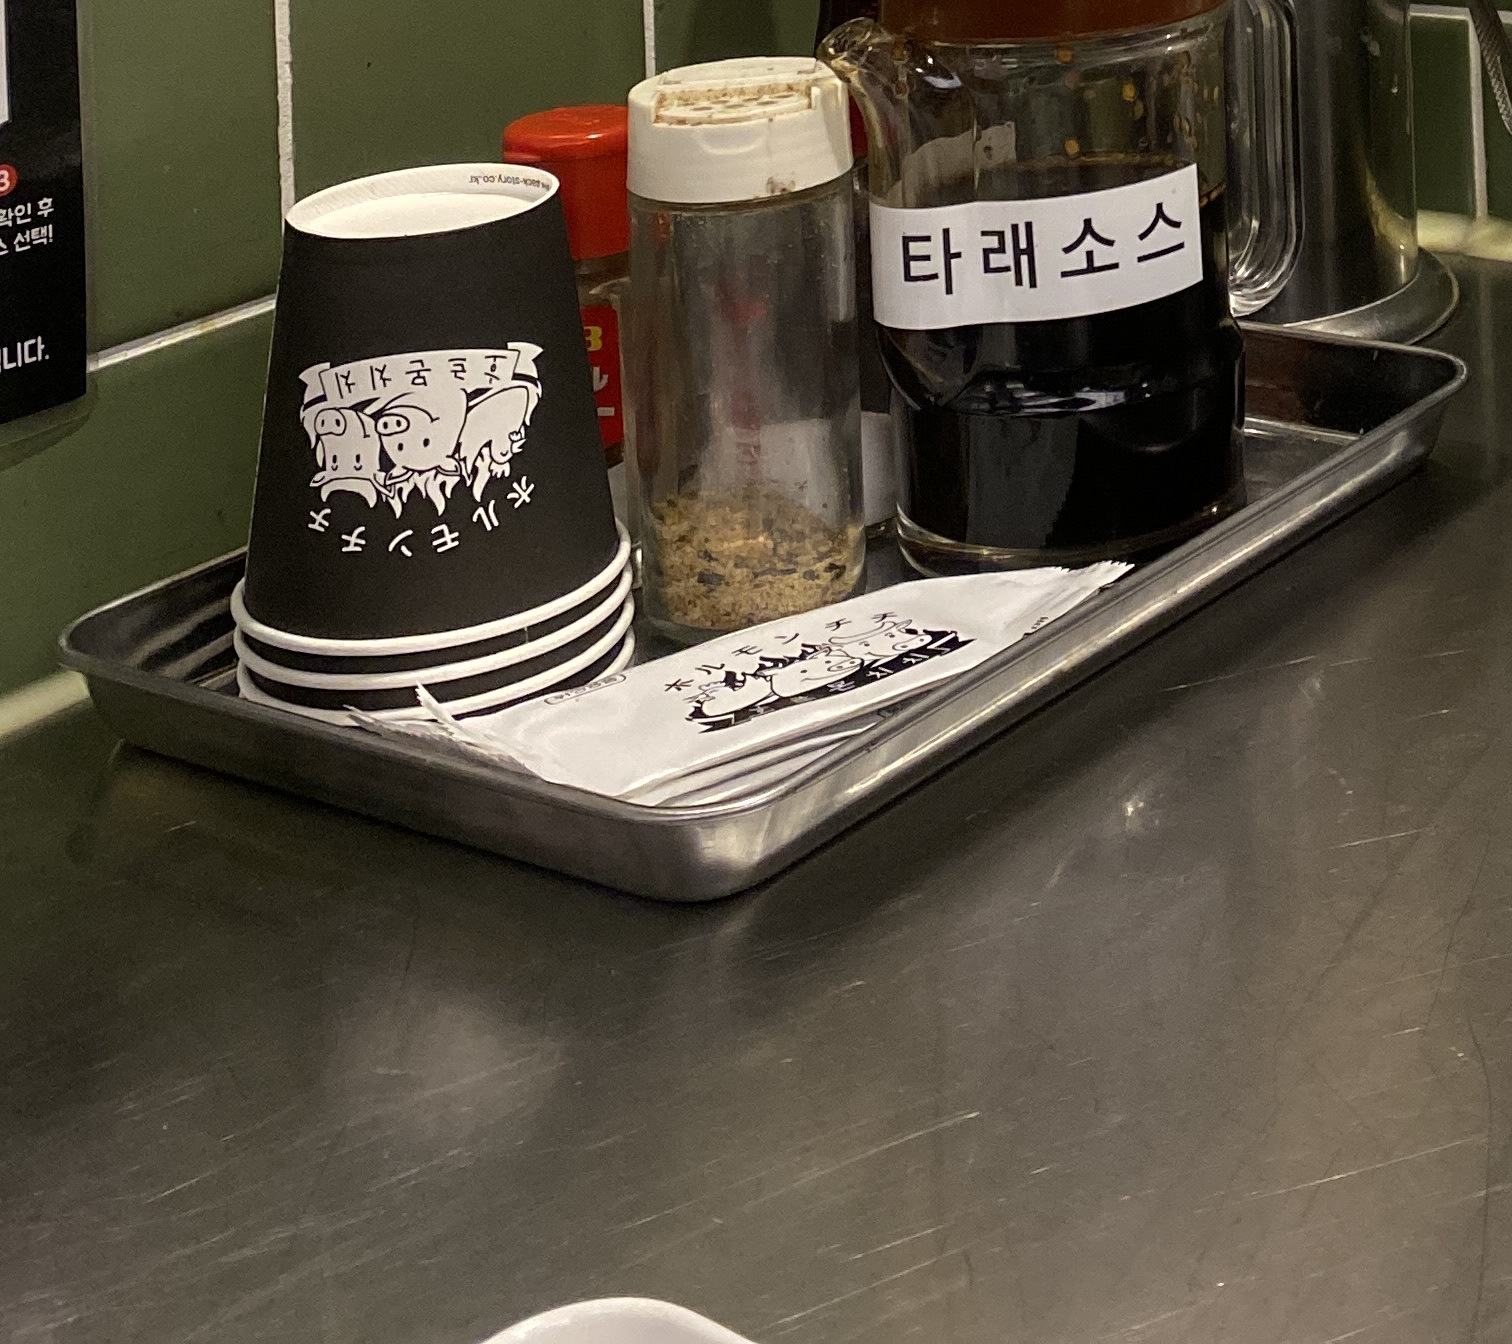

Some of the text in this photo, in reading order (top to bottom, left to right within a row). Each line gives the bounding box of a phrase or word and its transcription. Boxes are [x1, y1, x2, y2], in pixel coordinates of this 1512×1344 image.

[37, 197, 55, 218] 후
[13, 223, 54, 253] 선택!
[901, 201, 1185, 296] 타래소스
[0, 335, 50, 374] 니다.
[335, 355, 508, 400] 호르몬치치
[307, 475, 536, 558] ホルモンチチ
